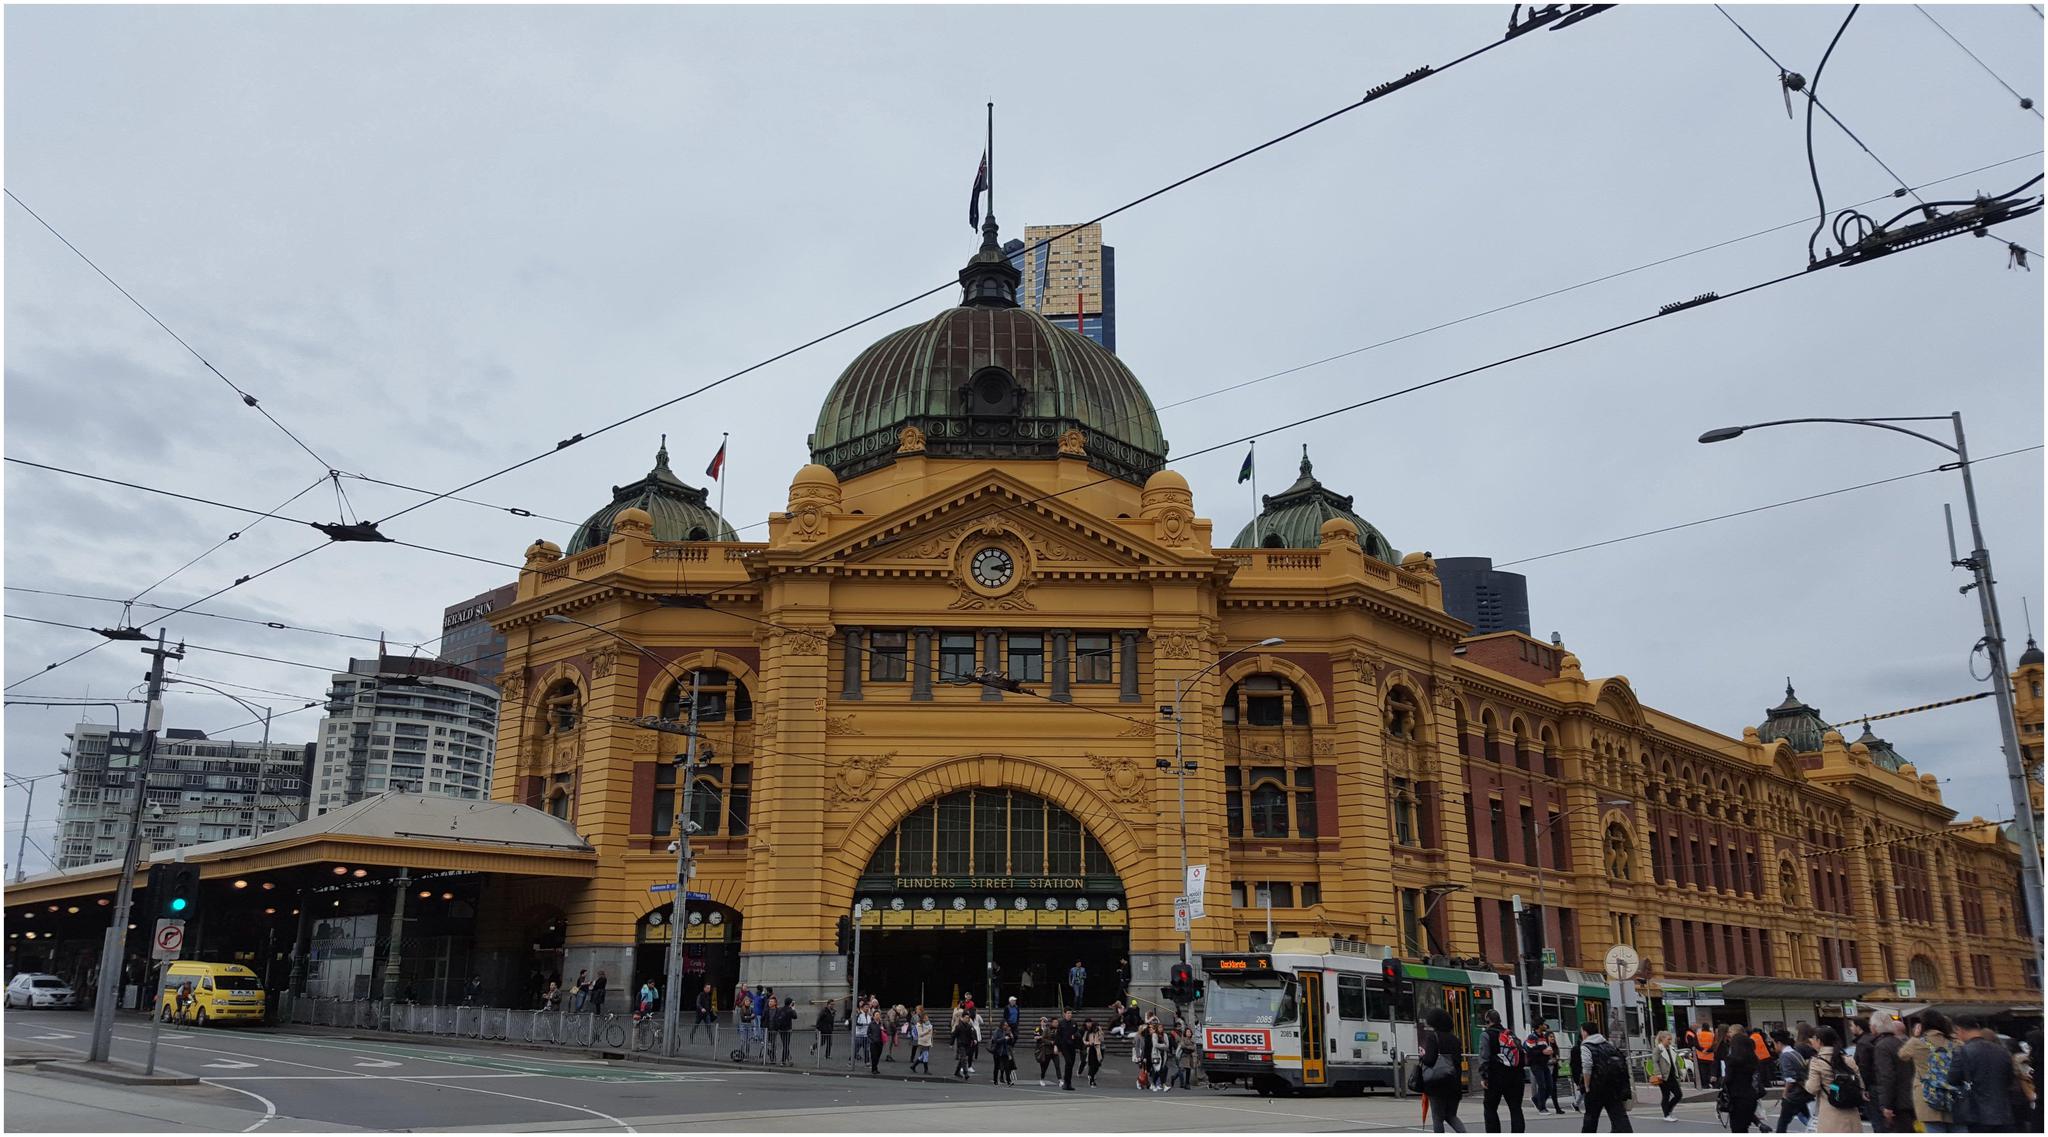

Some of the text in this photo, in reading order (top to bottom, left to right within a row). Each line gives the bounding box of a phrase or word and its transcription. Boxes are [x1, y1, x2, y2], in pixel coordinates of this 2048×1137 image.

[475, 601, 493, 617] SUN
[897, 878, 1084, 889] FLINDERS STREET STATION
[1258, 960, 1267, 968] 75
[1256, 1015, 1273, 1023] 2085
[1280, 1030, 1293, 1038] 2085
[1213, 1033, 1264, 1045] SCORSESE
